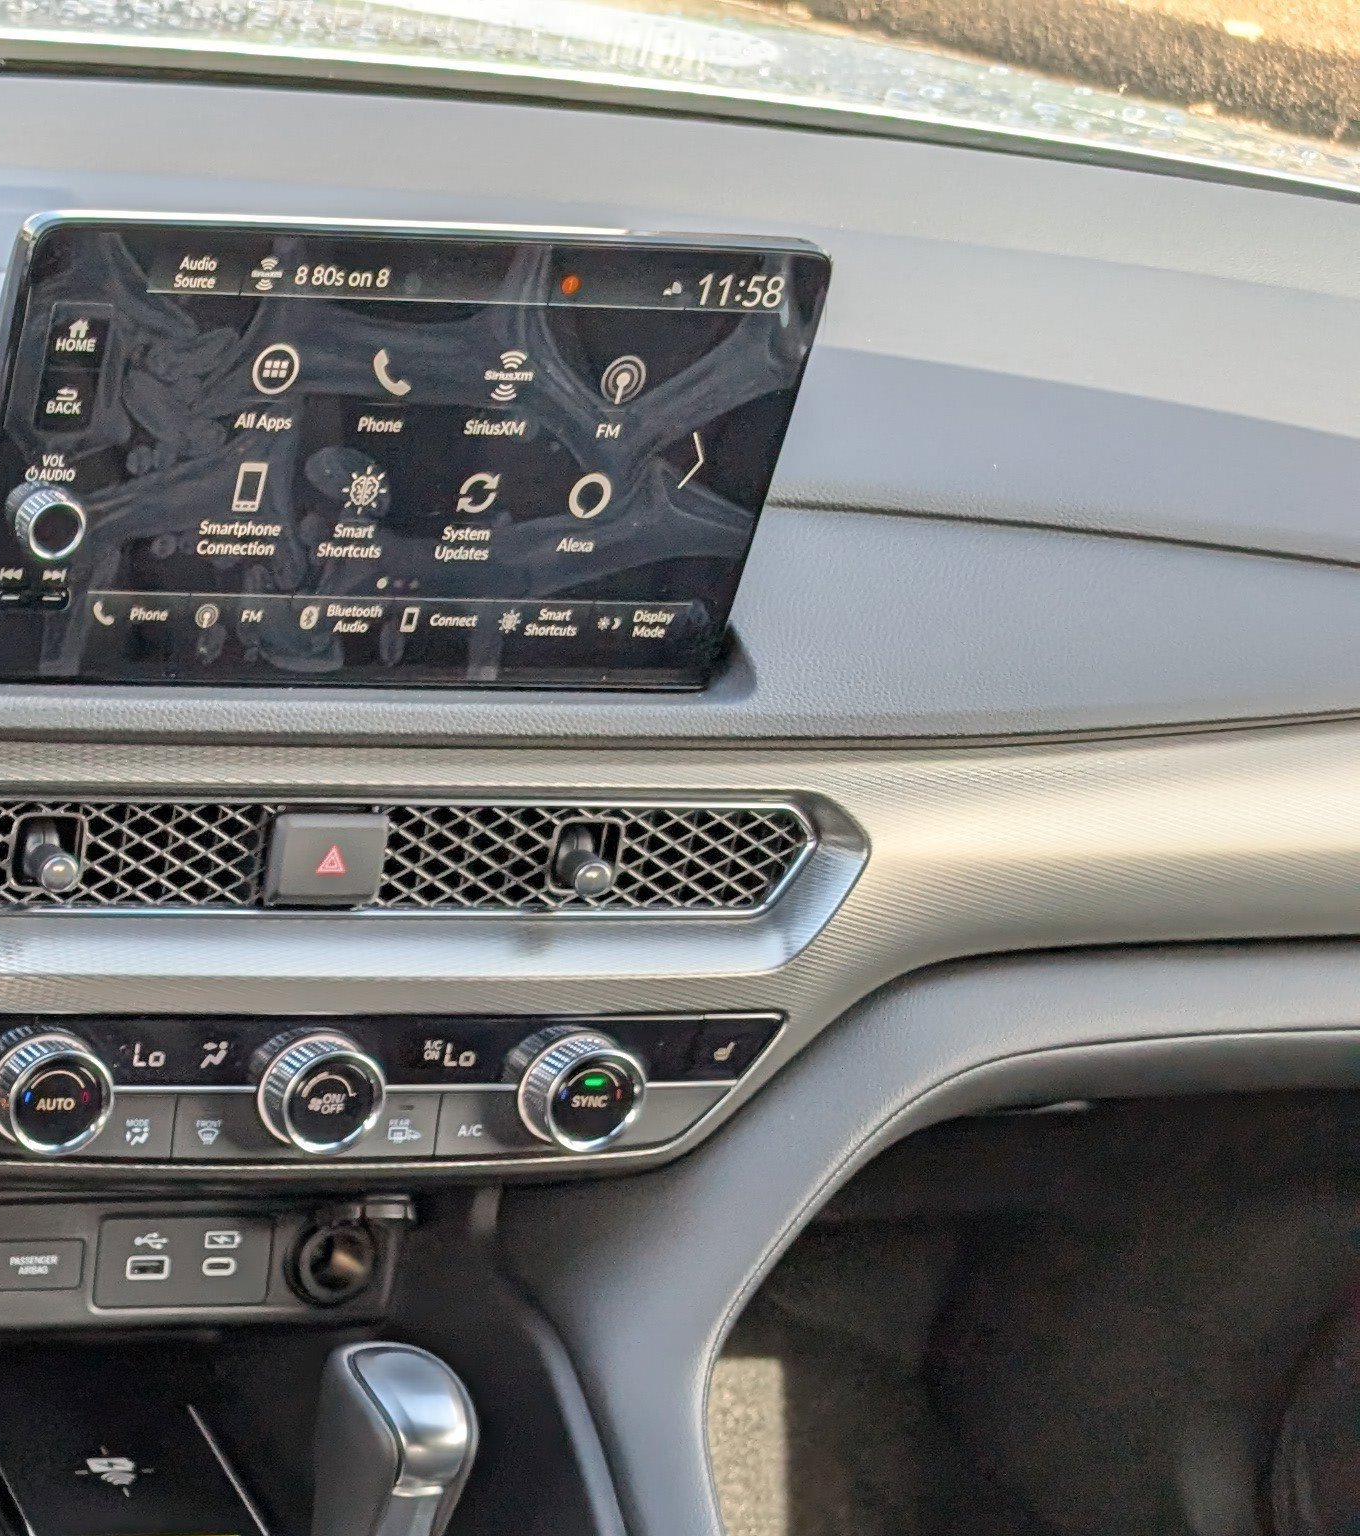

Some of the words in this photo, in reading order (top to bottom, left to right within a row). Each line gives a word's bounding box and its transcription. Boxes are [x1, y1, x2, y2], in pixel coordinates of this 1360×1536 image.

[179, 256, 218, 272] Audio
[174, 274, 217, 289] Source
[294, 264, 309, 286] 8
[311, 265, 346, 287] 80s
[348, 271, 373, 288] on
[376, 267, 391, 288] 8
[697, 272, 786, 309] 11:58
[55, 338, 97, 353] HOME
[46, 400, 82, 416] BACK
[234, 414, 256, 429] All
[256, 416, 292, 431] Apps
[357, 416, 403, 434] Phone
[463, 419, 526, 438] SiriusXM
[595, 424, 621, 440] FM
[42, 455, 65, 467] VOL
[39, 468, 76, 482] AUDIO
[199, 521, 281, 539] Smartphone
[333, 523, 375, 540] Smart
[442, 525, 492, 543] System
[196, 541, 275, 558] Connection
[317, 543, 382, 560] Shortcuts
[555, 537, 595, 554] Alexa
[434, 545, 490, 563] Updates
[129, 606, 169, 622] Phone
[241, 609, 263, 623] FM
[326, 603, 383, 619] Bluetooth
[538, 608, 572, 622] Smart
[633, 609, 675, 625] Display
[332, 619, 369, 634] Audio
[429, 613, 478, 628] Connect
[524, 623, 578, 638] Shortcuts
[632, 625, 666, 638] Mode
[35, 1097, 76, 1112] AUTO
[320, 1104, 344, 1115] OFF
[570, 1095, 608, 1109] SYNC
[125, 1118, 150, 1127] MODE
[196, 1119, 222, 1128] FRONT
[457, 1123, 483, 1137] A/C
[9, 1255, 59, 1265] PASSENGER
[18, 1265, 49, 1275] AIRBAG
